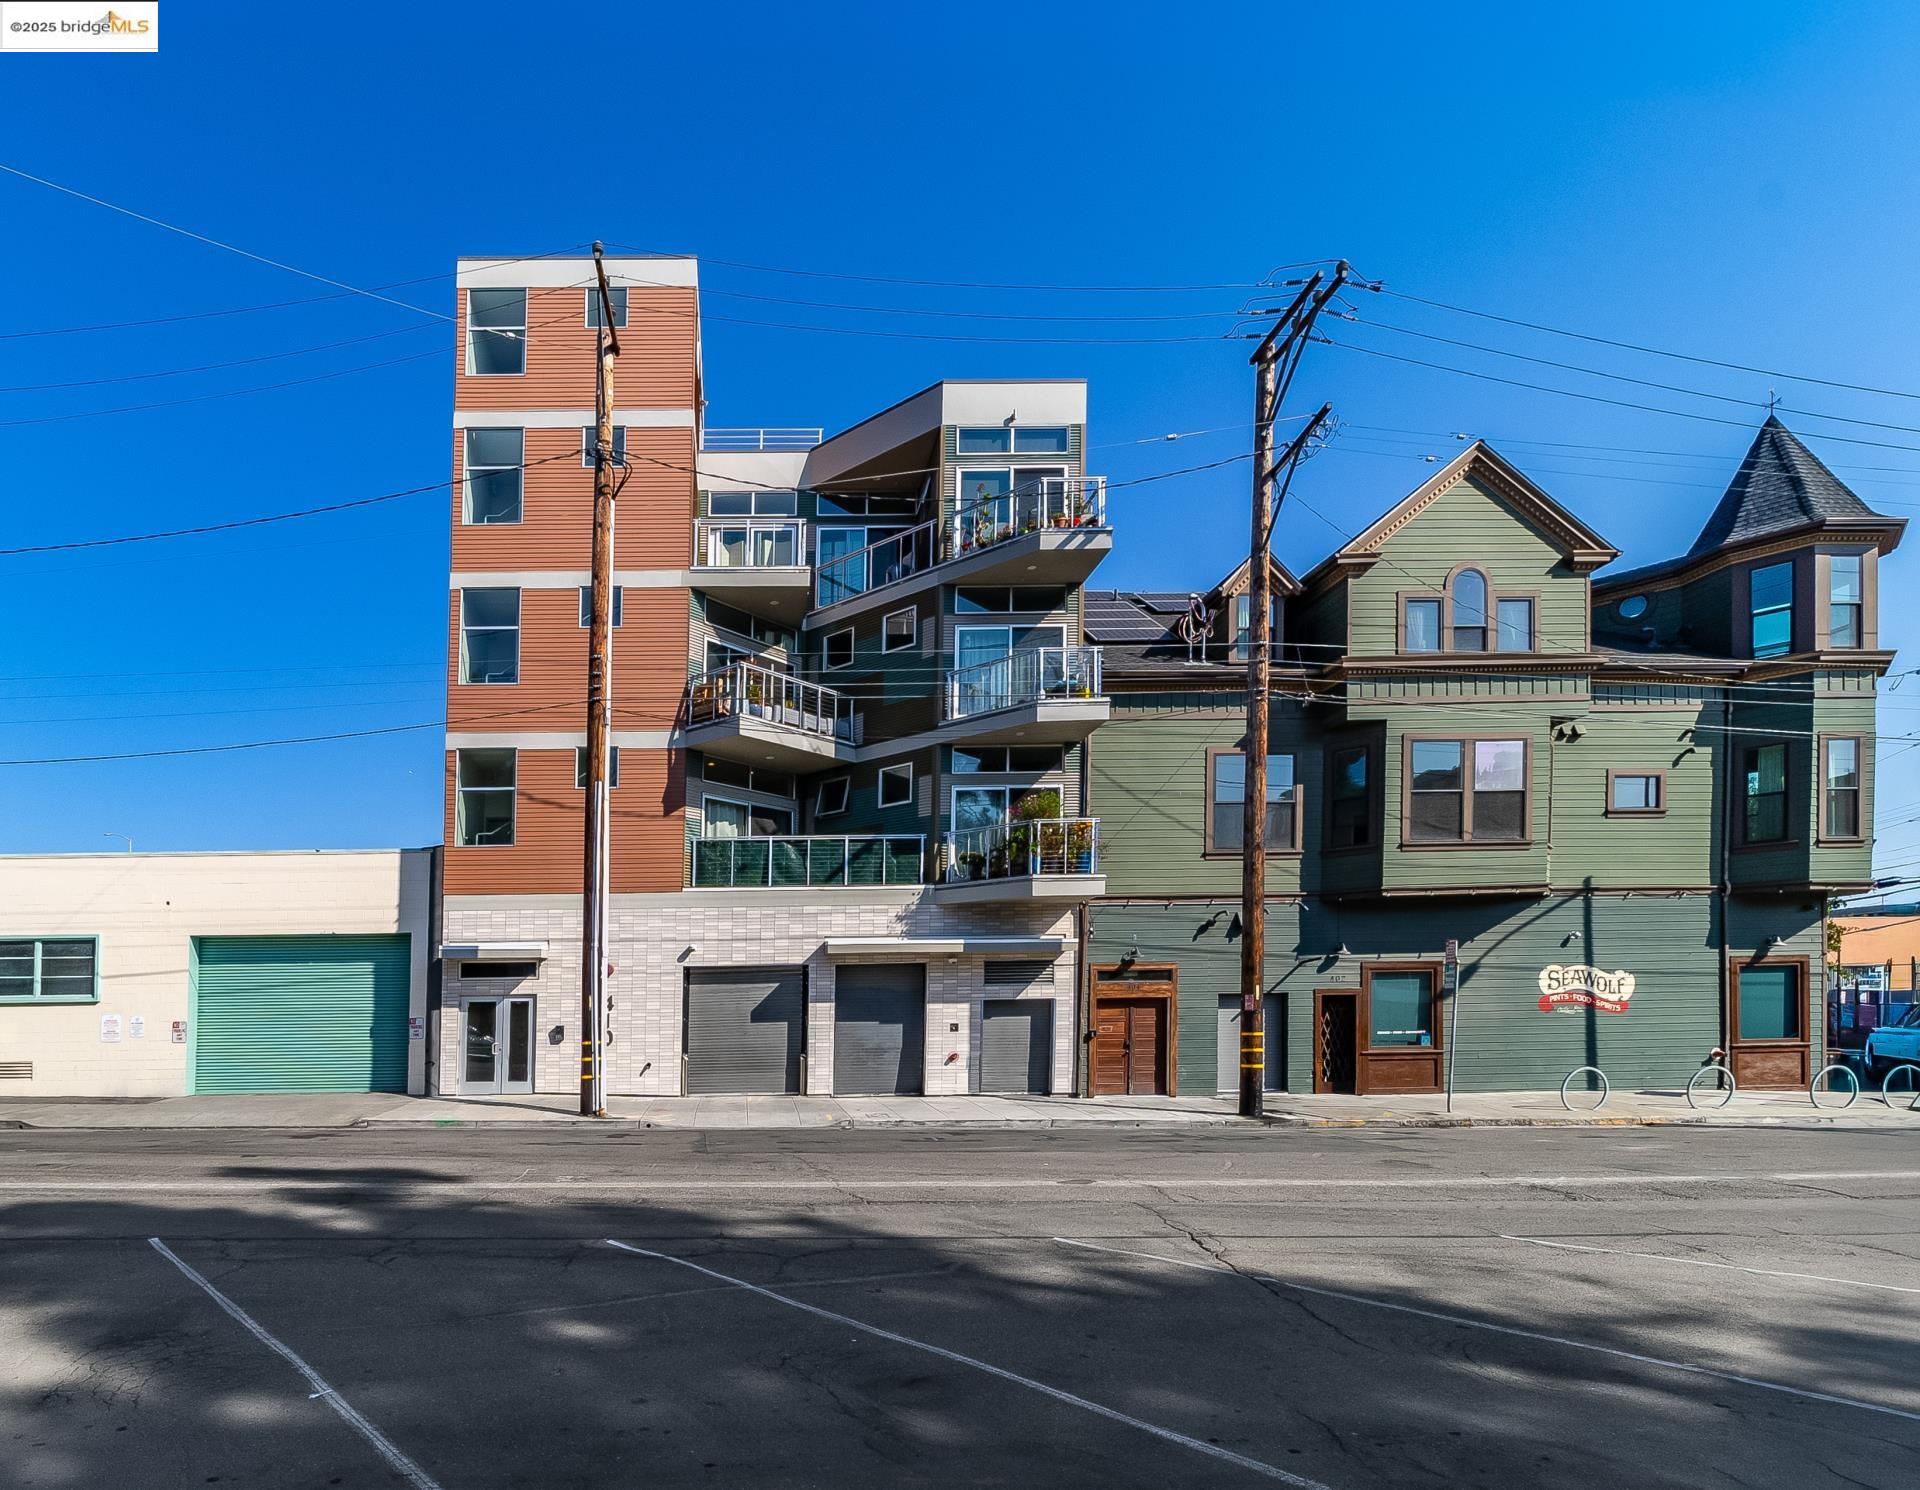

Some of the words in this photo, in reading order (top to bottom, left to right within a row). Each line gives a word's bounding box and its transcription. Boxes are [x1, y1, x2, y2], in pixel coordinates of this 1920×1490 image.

[1548, 969, 1625, 994] SEAWOLF
[1549, 994, 1569, 1003] PINTS
[1573, 994, 1592, 1004] FOOD
[1595, 999, 1621, 1012] SPIRITS
